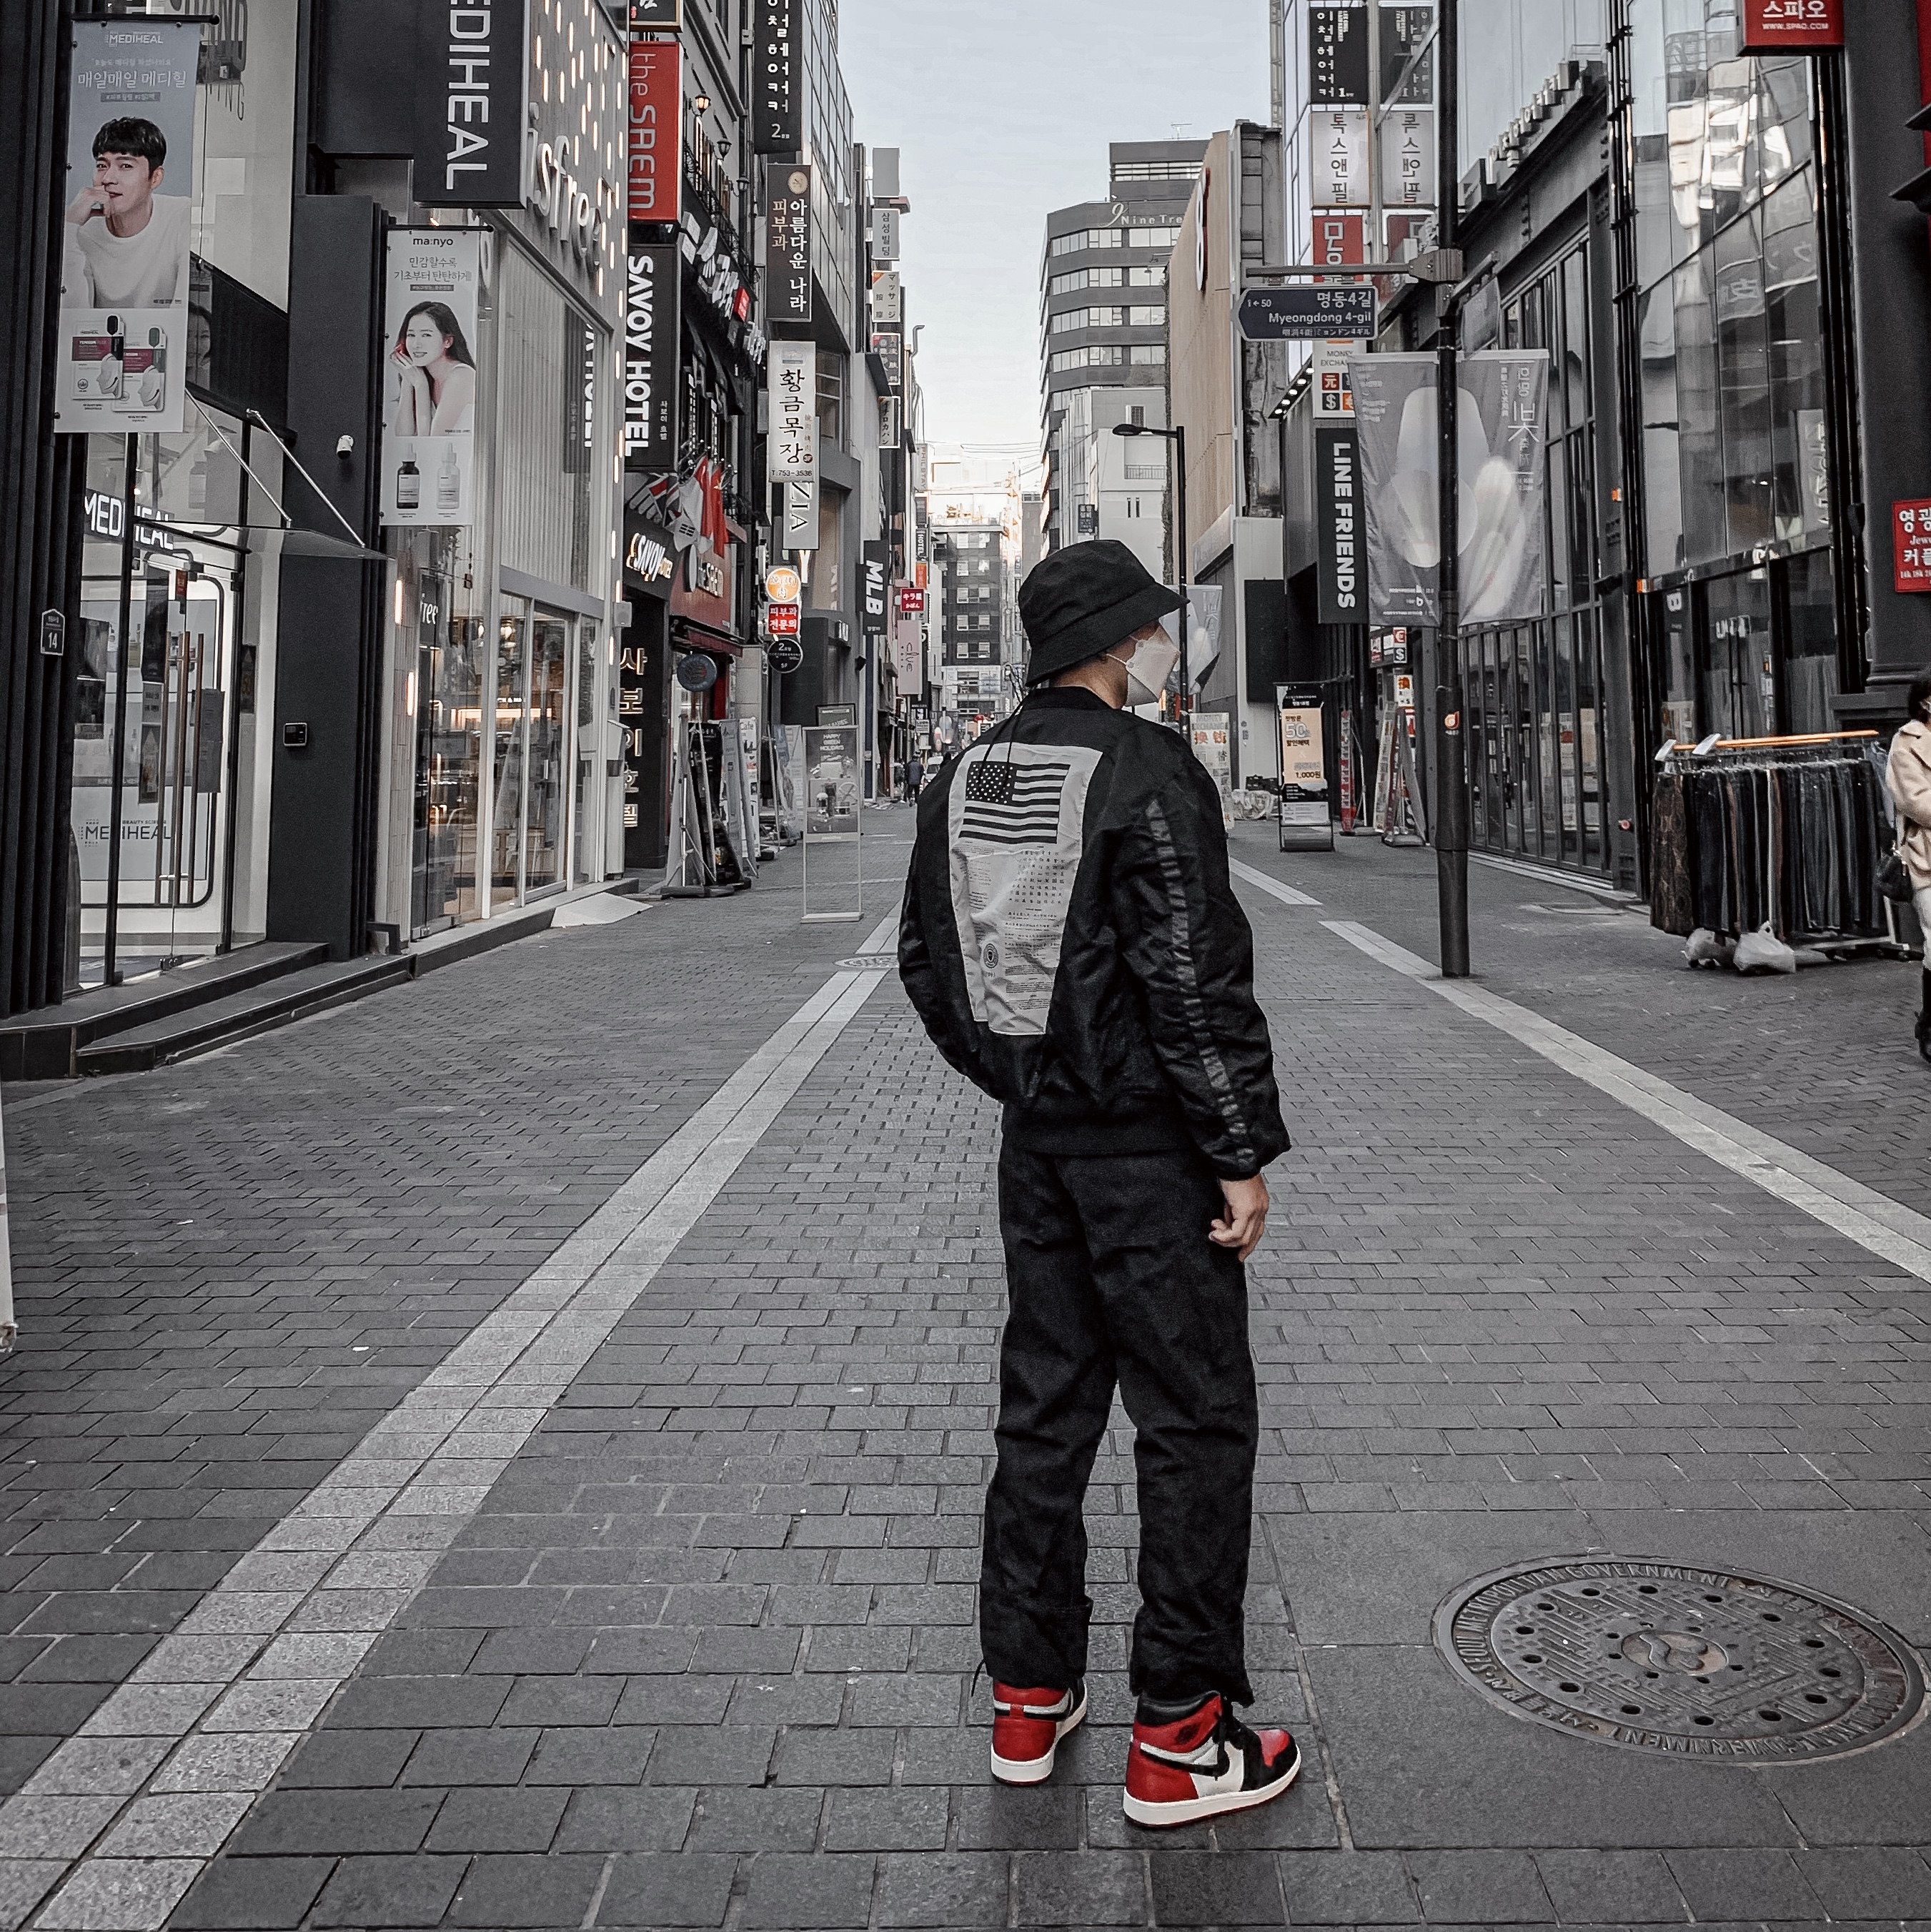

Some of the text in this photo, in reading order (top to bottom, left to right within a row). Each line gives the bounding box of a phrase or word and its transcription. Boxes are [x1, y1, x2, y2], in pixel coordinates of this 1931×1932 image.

[1762, 0, 1827, 19] 스파오
[109, 34, 164, 44] MEDIHEAL
[79, 71, 187, 89] 매일매일 메디힐
[446, 0, 491, 190] DIHEAL
[630, 53, 656, 96] the
[1330, 114, 1348, 204] 톡스앤필
[771, 199, 788, 252] 피부과
[882, 212, 890, 256] 삼성빌딩
[1121, 216, 1155, 225] Nine
[789, 198, 808, 312] 아름다운 나라
[888, 274, 896, 319] マッサージ
[1269, 313, 1371, 324] Myeongdong 4-gil
[1317, 292, 1371, 308] 명동4길
[625, 255, 655, 457] SAVOY HOTEL
[778, 369, 805, 464] 황금목장
[1333, 442, 1356, 608] LINE FRIENDS
[865, 560, 884, 615] MLB
[49, 632, 57, 648] 14
[1565, 1562, 1732, 1589] GOVERNMENT
